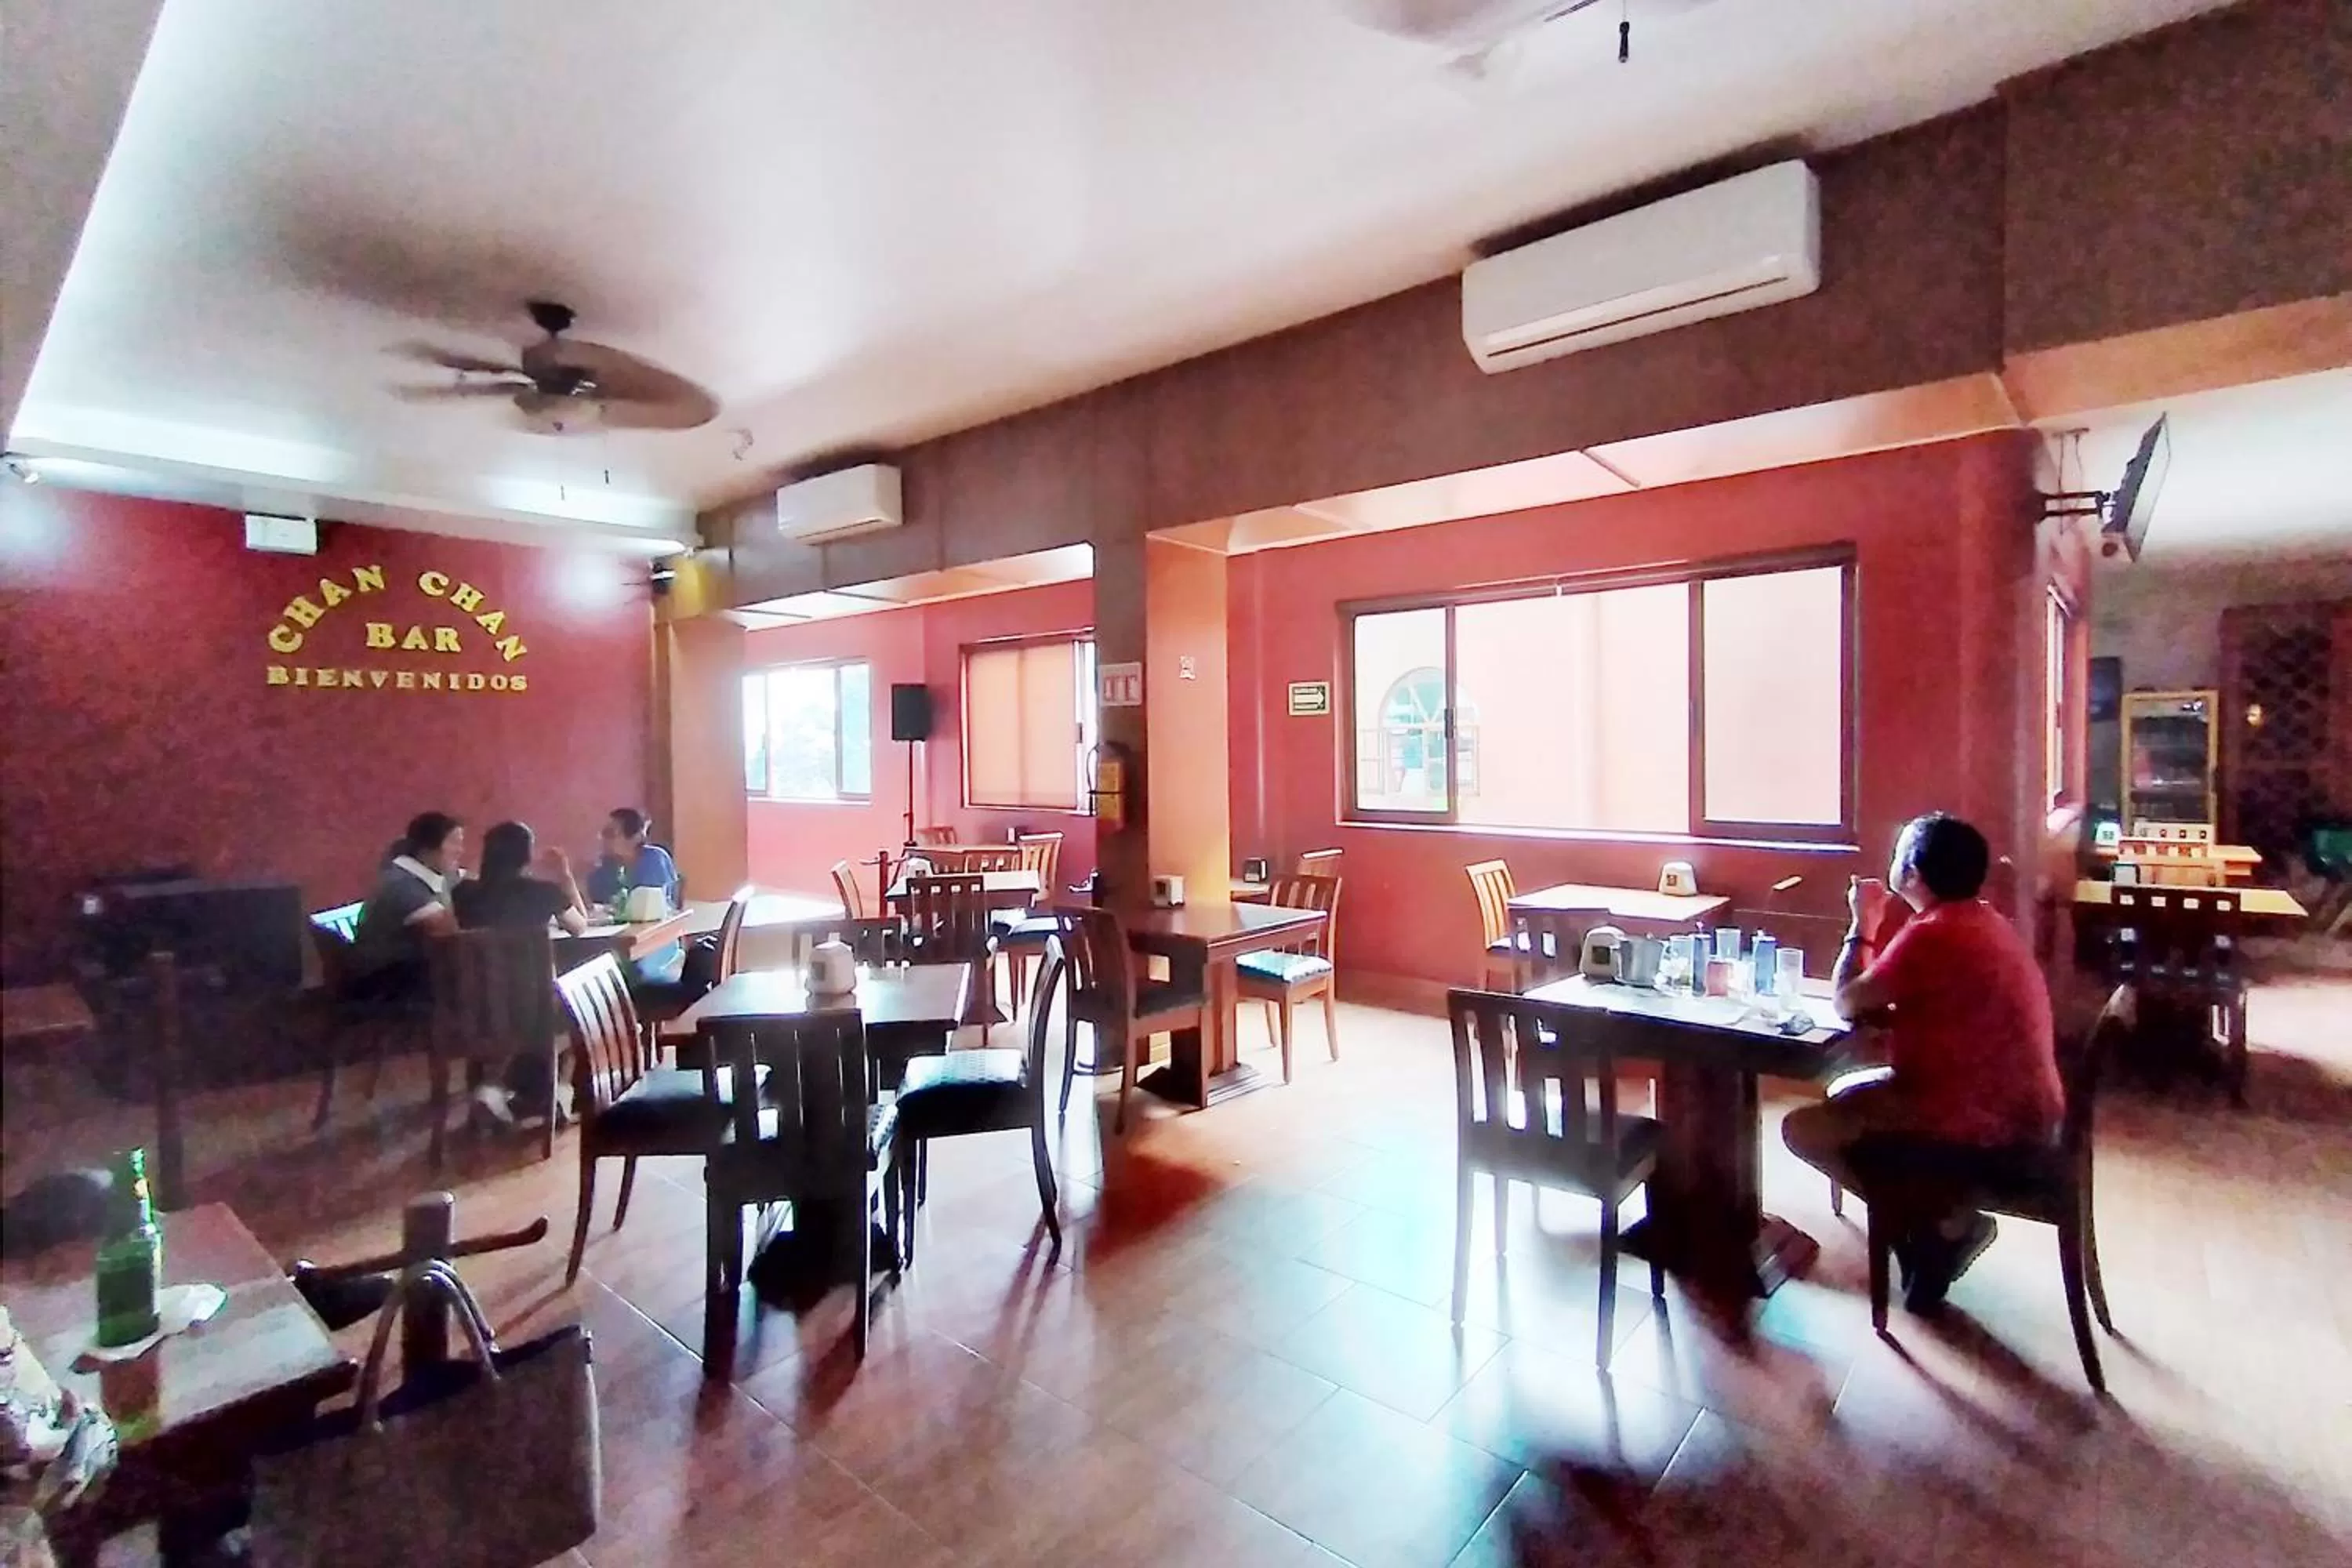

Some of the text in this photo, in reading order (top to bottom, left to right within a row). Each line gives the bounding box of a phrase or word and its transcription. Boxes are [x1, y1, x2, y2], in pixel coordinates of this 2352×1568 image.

[268, 564, 528, 662] CHAN CHAN
[365, 622, 462, 653] BAR
[267, 665, 528, 691] BIENVENIDOS
